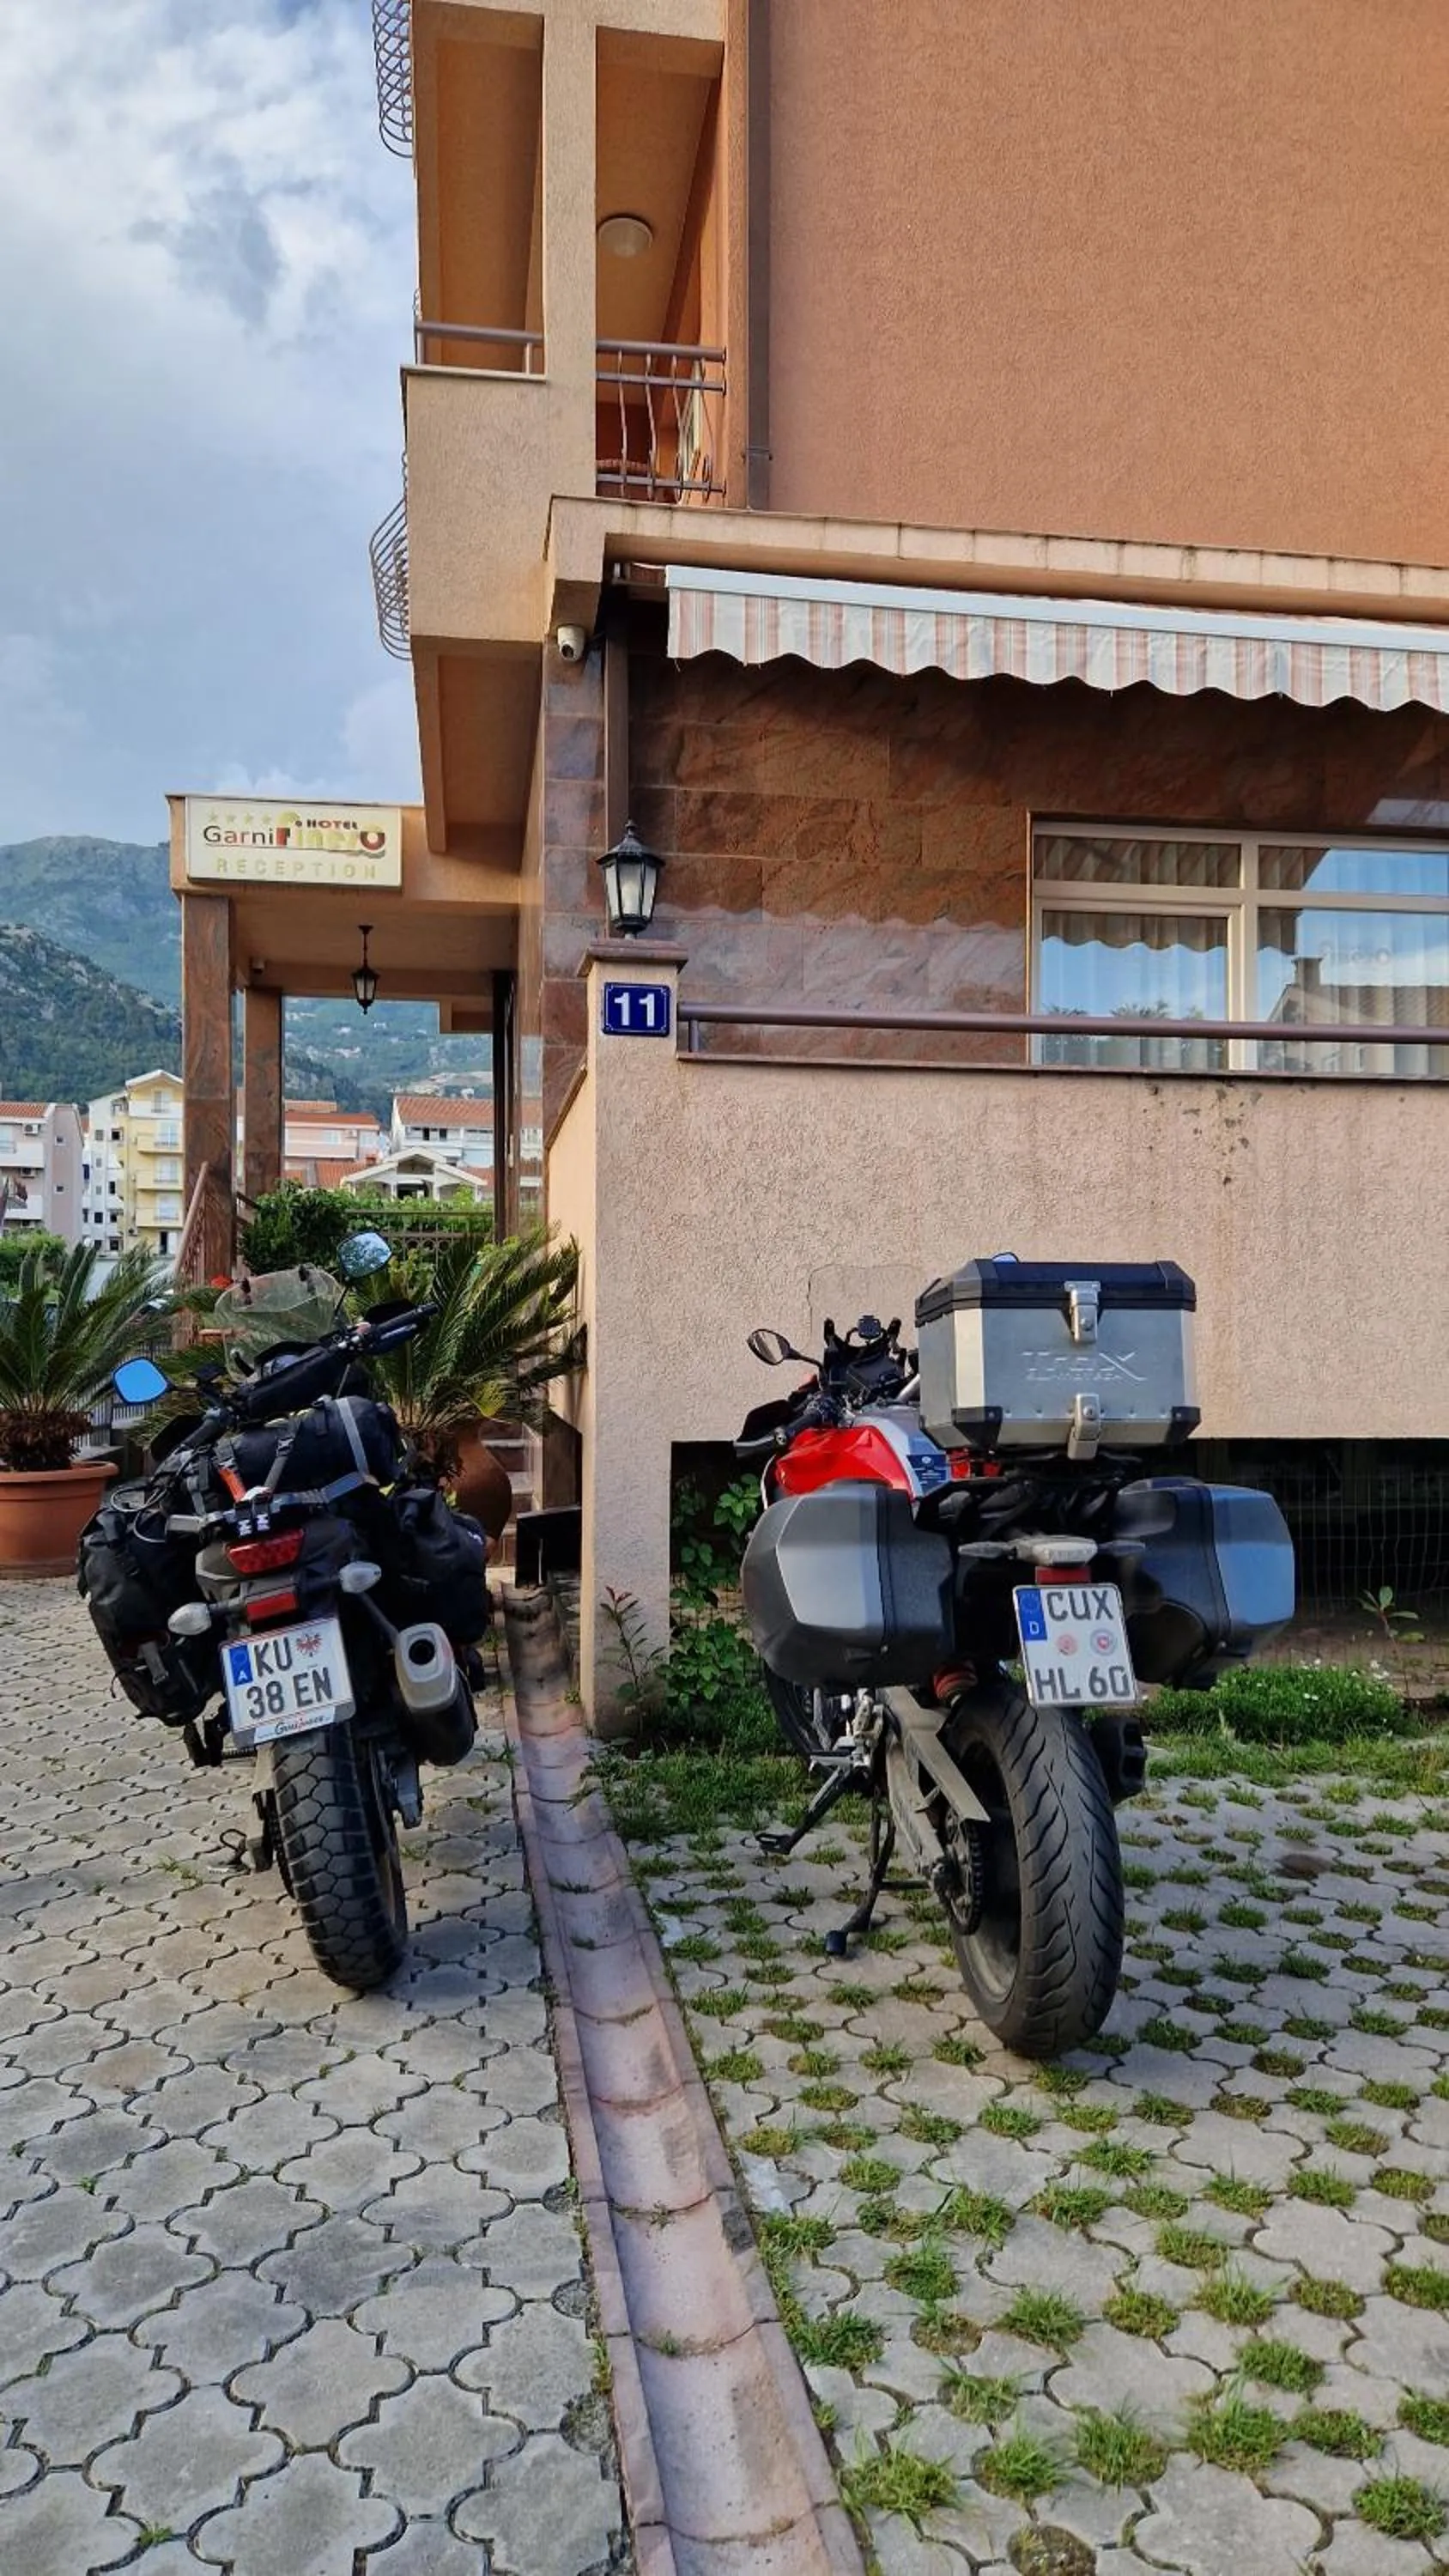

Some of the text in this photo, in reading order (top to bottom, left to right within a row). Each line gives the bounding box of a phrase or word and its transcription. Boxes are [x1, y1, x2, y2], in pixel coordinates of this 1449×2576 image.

[203, 825, 273, 846] Garni
[306, 818, 358, 830] HOTEL
[217, 858, 376, 879] RECEPTION
[614, 992, 655, 1028] 11
[1046, 1590, 1114, 1621] CUX
[1029, 1621, 1040, 1635] D
[254, 1637, 293, 1677] KU
[238, 1670, 249, 1681] A
[1034, 1666, 1131, 1700] HL 60
[246, 1667, 333, 1719] 38 EN
